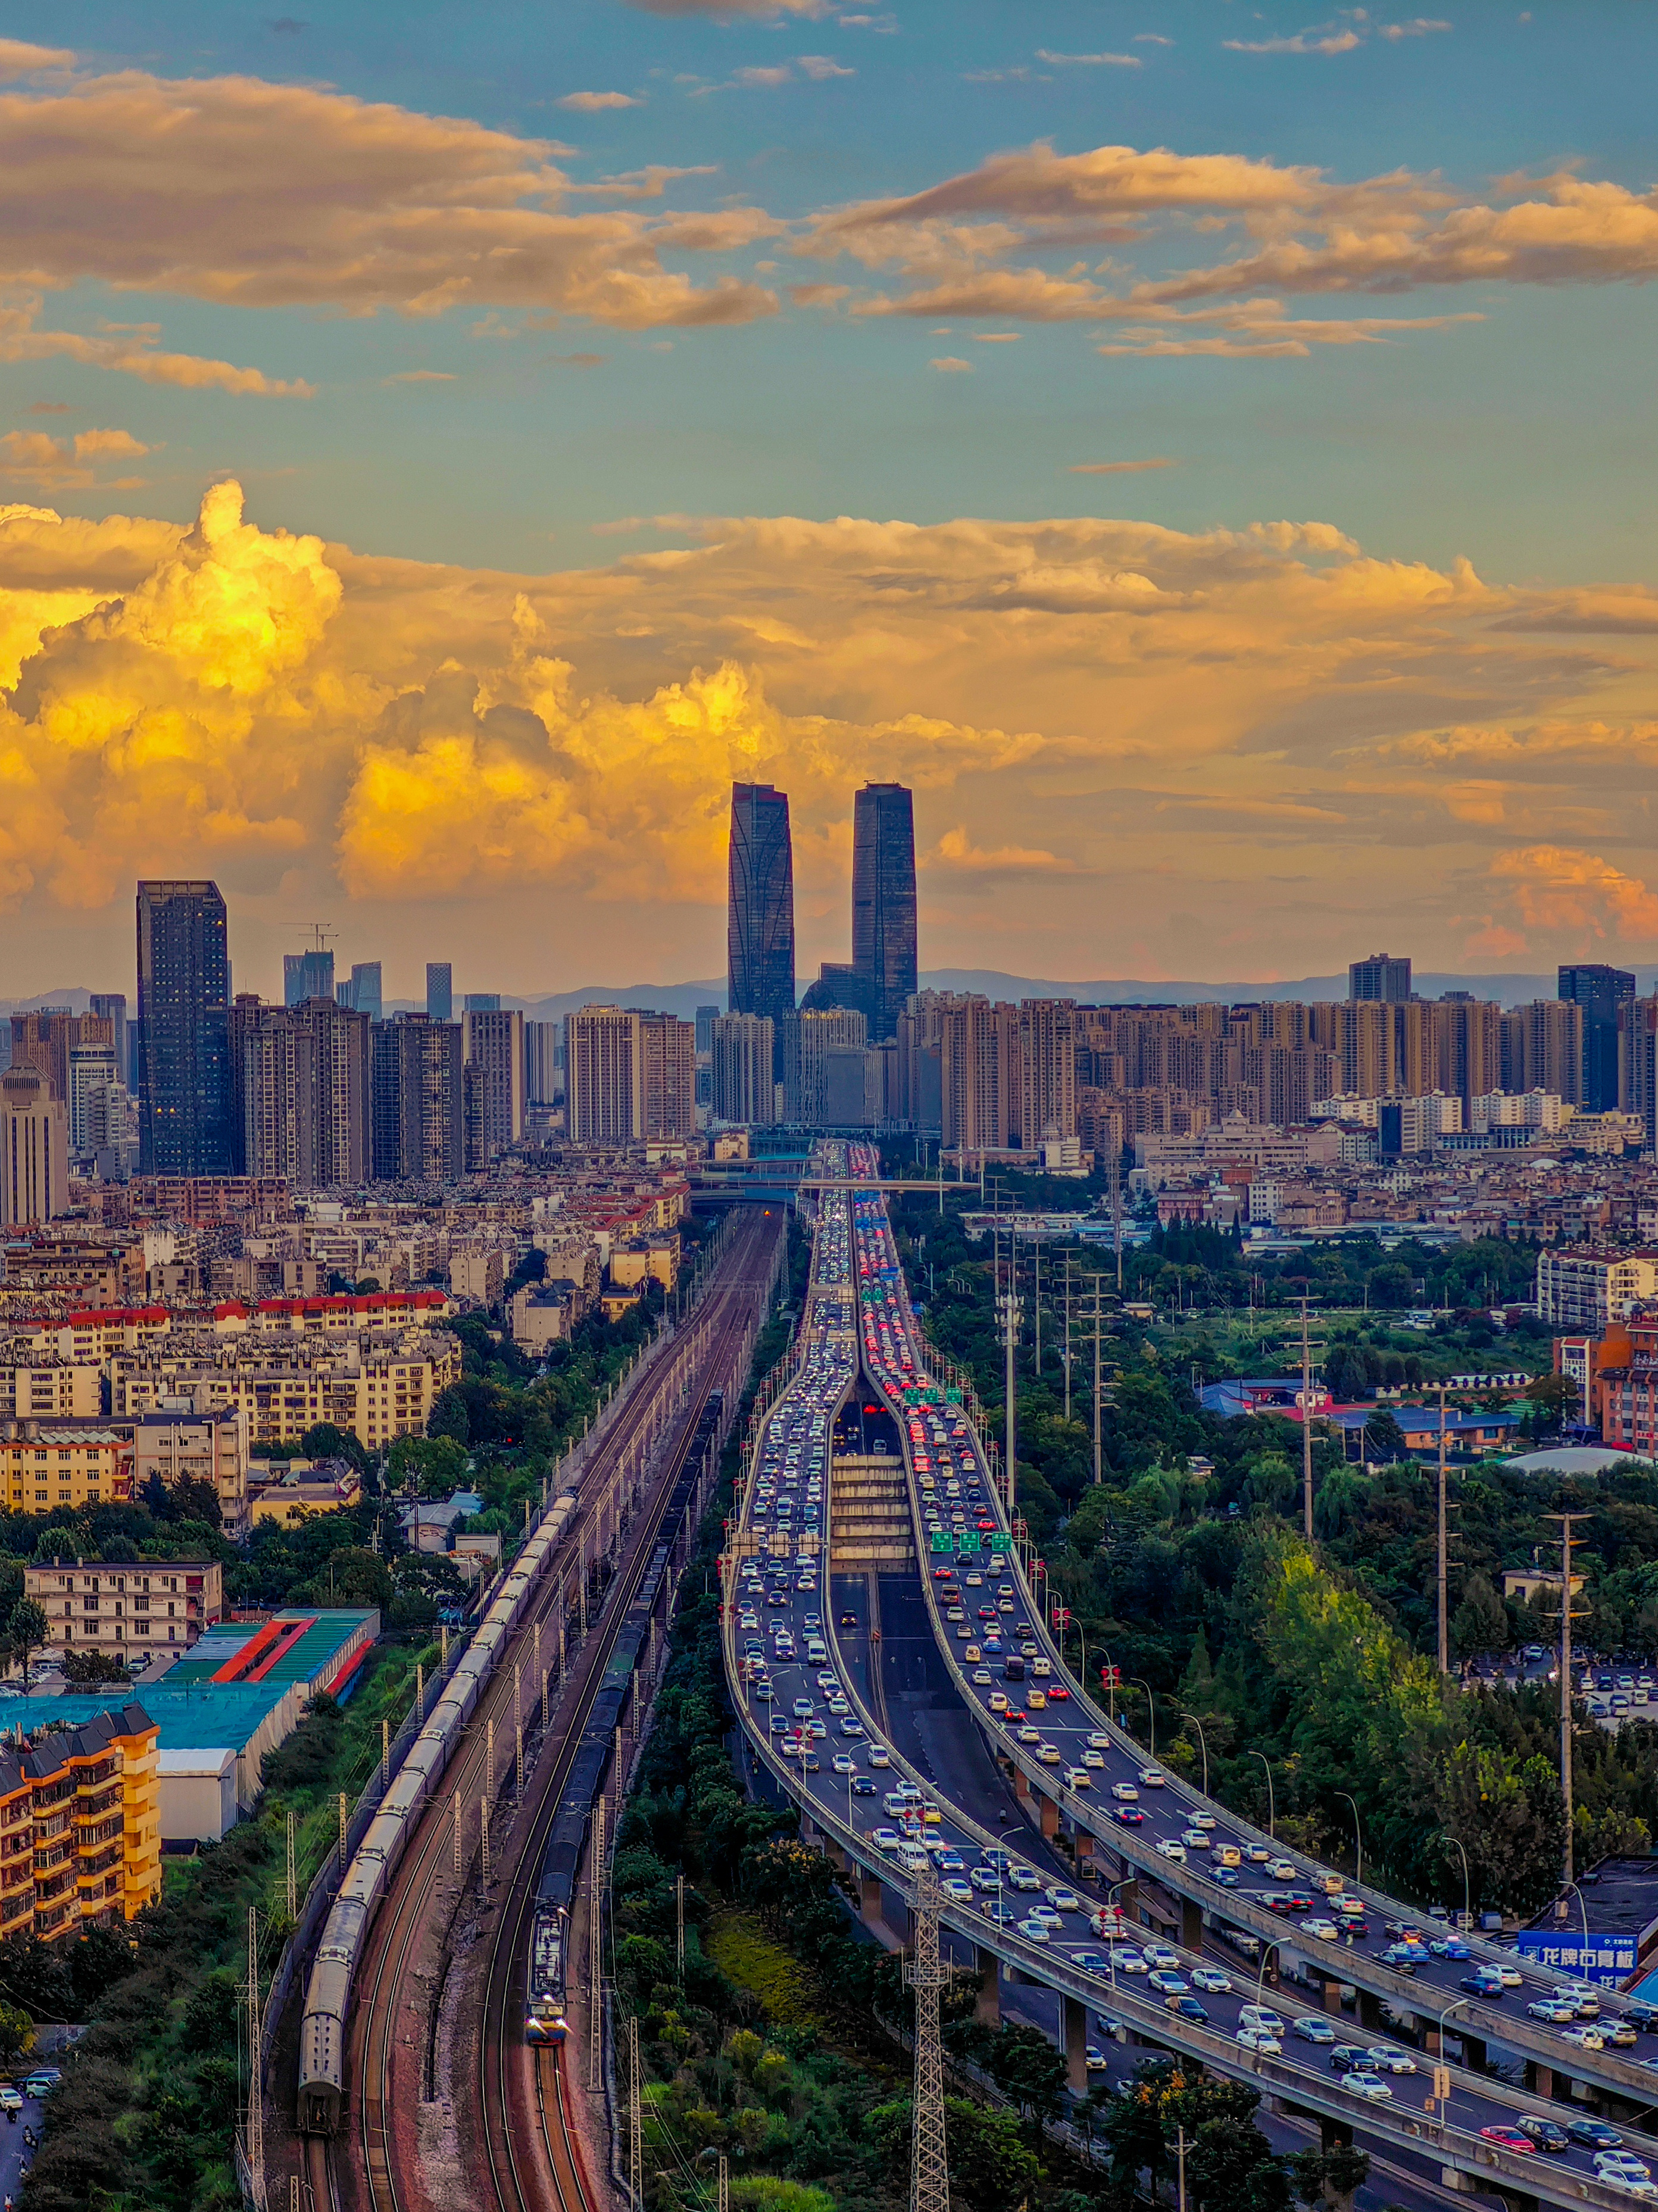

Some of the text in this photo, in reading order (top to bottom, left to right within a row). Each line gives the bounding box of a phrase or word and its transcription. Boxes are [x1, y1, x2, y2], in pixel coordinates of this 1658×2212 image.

[1542, 1946, 1634, 1968] 龙牌石膏板
